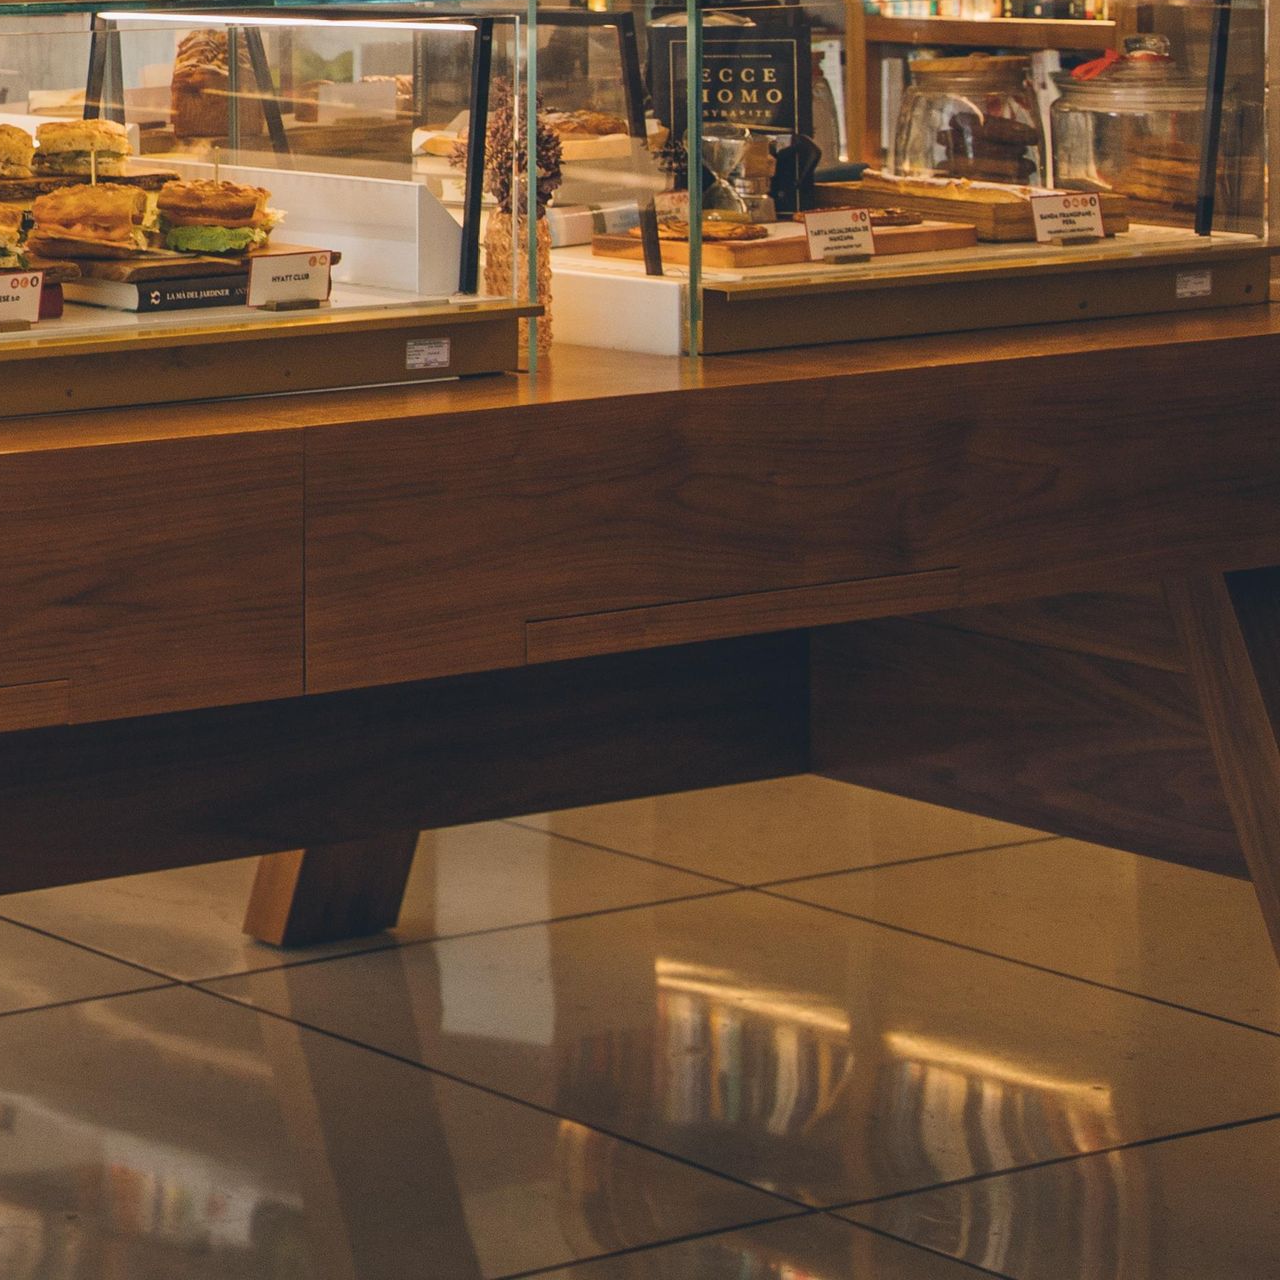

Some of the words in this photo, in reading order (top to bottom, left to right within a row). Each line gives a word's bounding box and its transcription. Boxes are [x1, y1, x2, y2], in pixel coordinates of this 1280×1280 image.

[702, 67, 778, 83] ECCE
[271, 274, 293, 283] HYATT
[294, 272, 310, 282] CLUB
